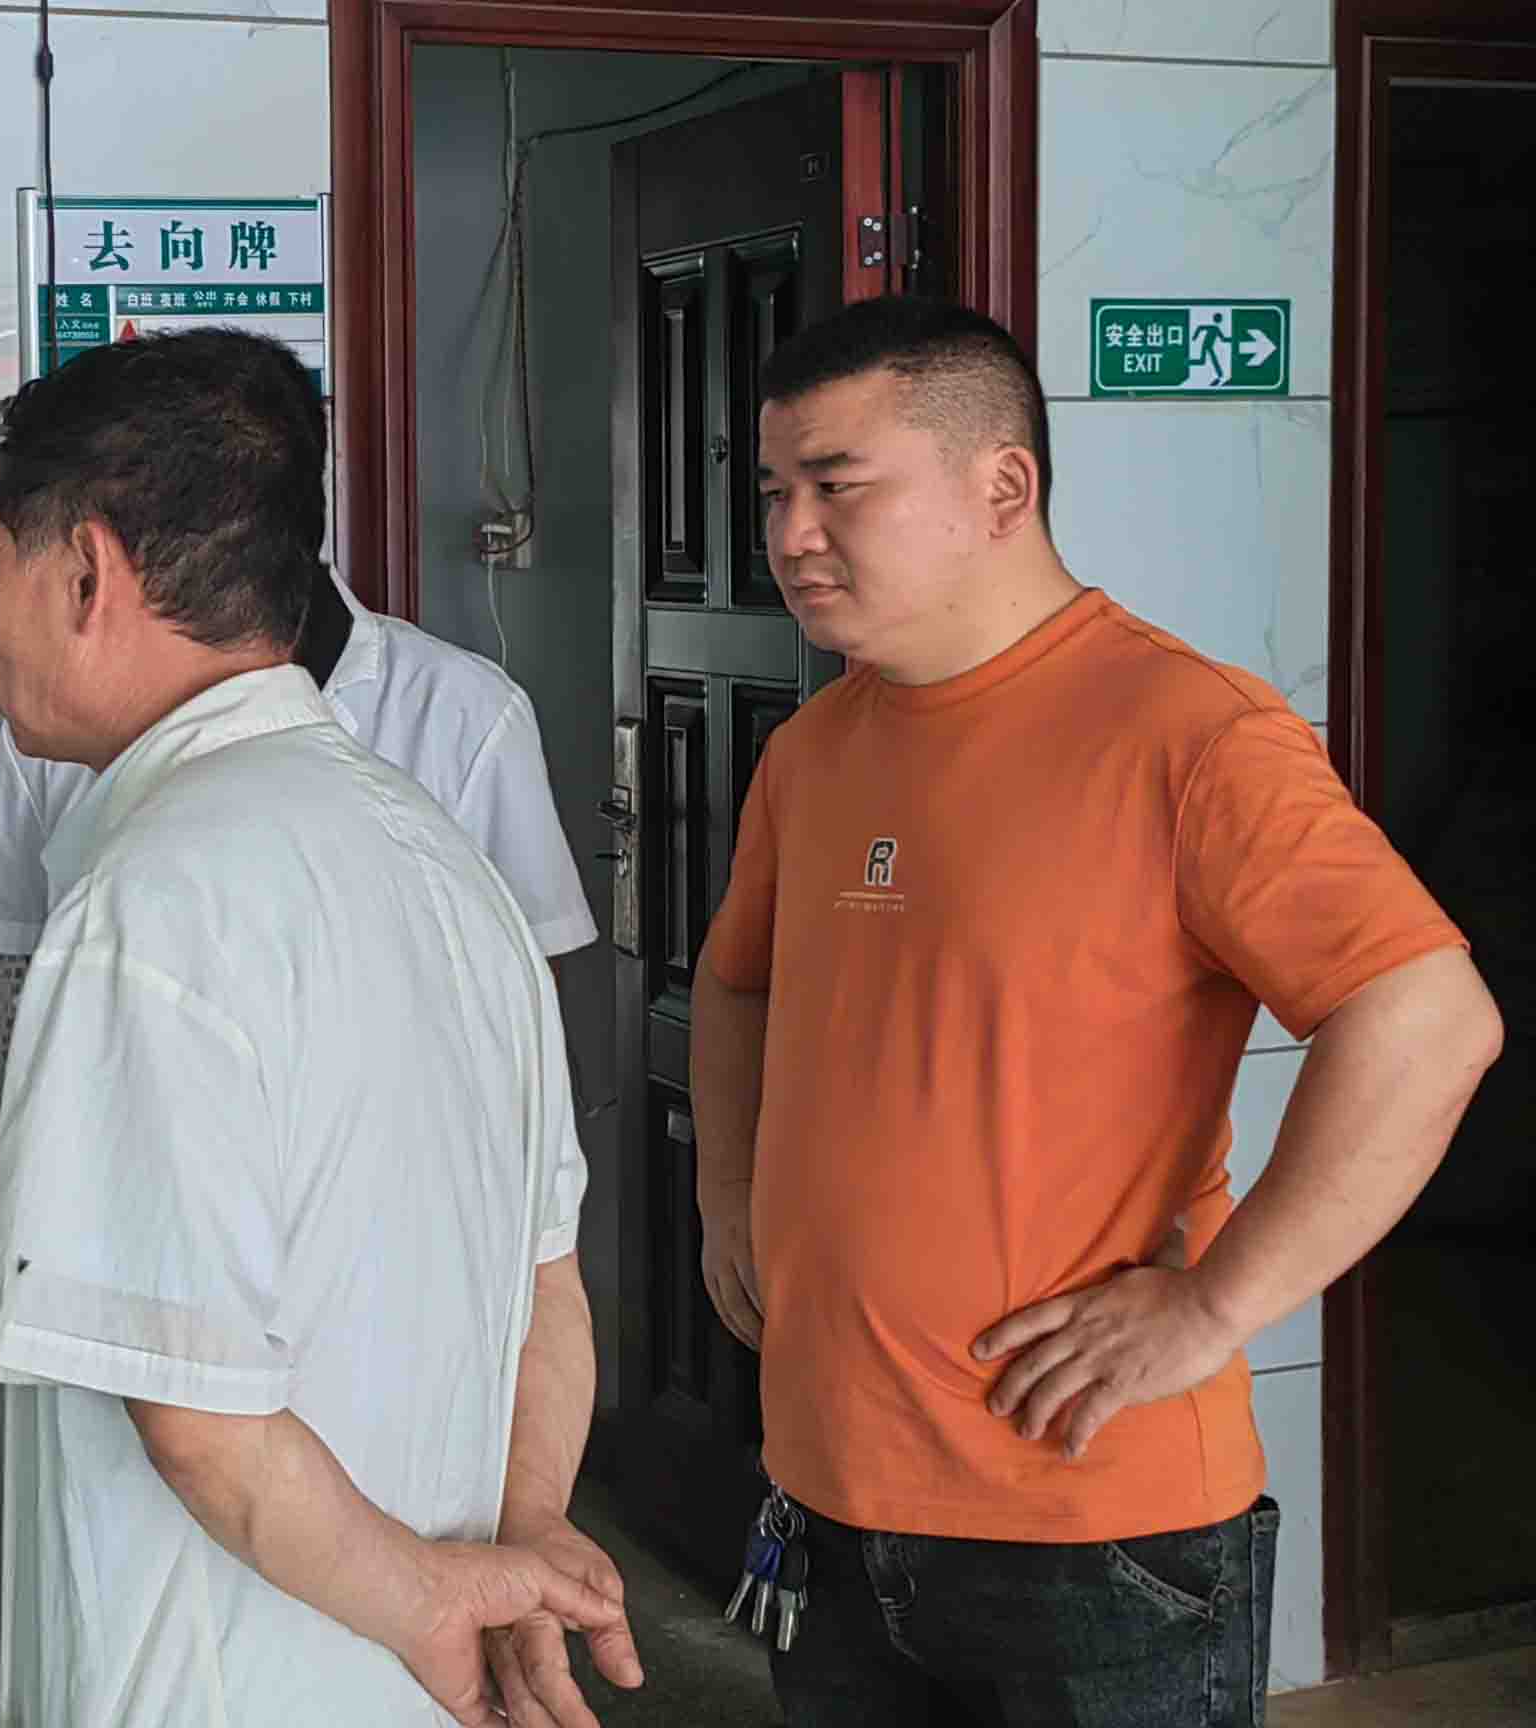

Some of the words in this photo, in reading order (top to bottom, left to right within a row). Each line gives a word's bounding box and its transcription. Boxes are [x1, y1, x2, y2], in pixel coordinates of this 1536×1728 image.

[84, 220, 278, 271] 去向牌
[1105, 322, 1183, 347] 安全出口
[1124, 353, 1162, 373] EXIT
